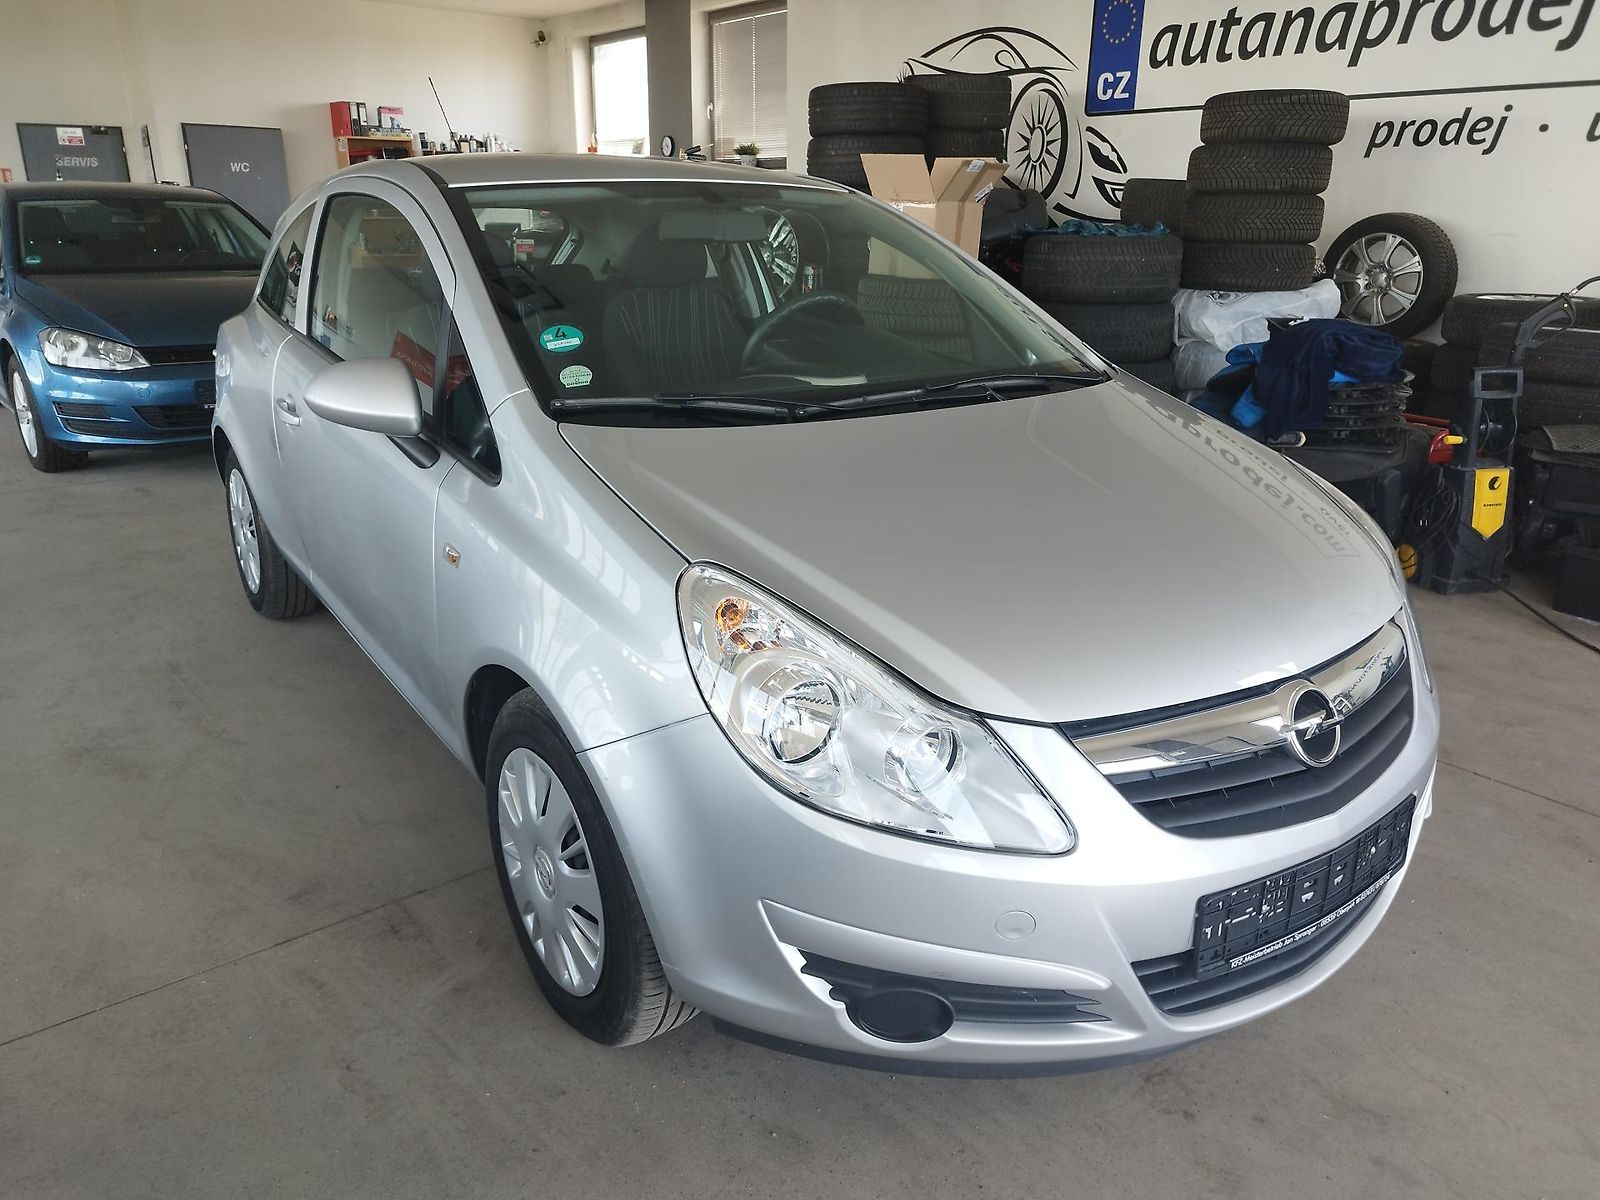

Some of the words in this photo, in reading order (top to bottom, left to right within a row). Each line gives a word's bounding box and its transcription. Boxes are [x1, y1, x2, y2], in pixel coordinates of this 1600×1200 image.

[1096, 71, 1131, 101] CZ
[1364, 104, 1514, 158] prodej
[56, 155, 98, 168] SERVIS
[230, 162, 250, 172] WC
